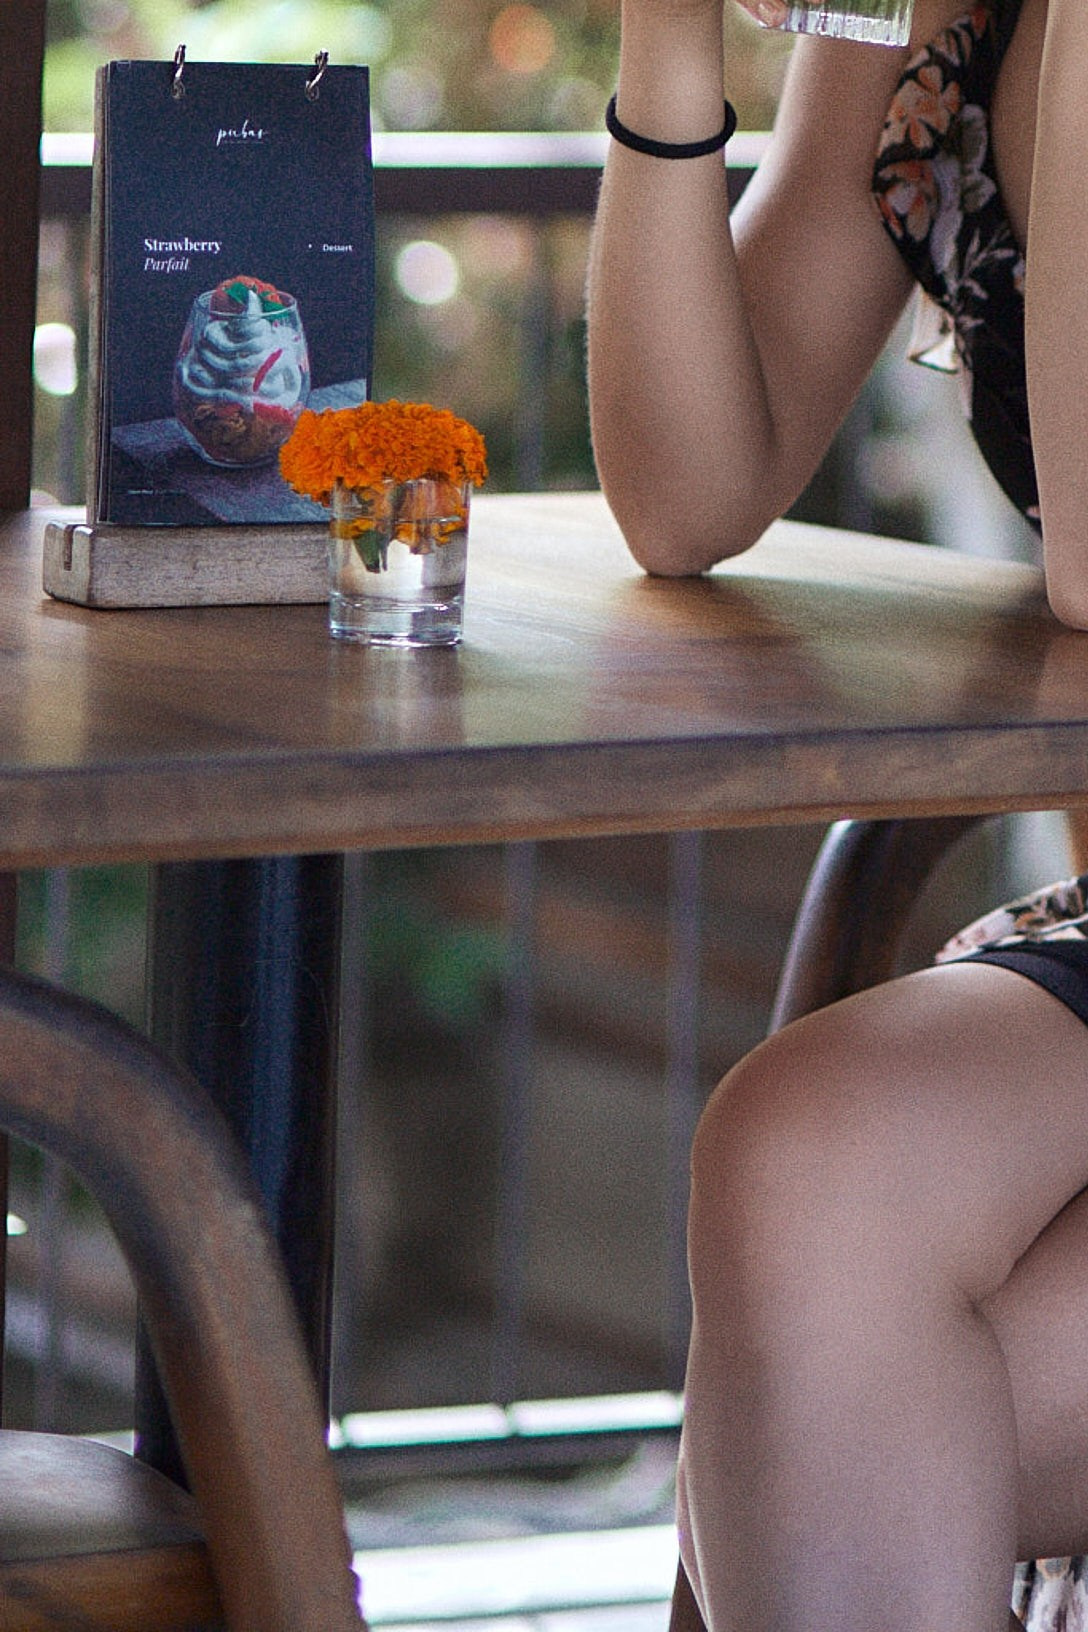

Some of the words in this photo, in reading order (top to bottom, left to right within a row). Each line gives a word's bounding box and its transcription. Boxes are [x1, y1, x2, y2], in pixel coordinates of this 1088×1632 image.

[144, 237, 222, 254] Strawberry
[322, 243, 353, 252] Dessert
[144, 257, 189, 273] Parfait
